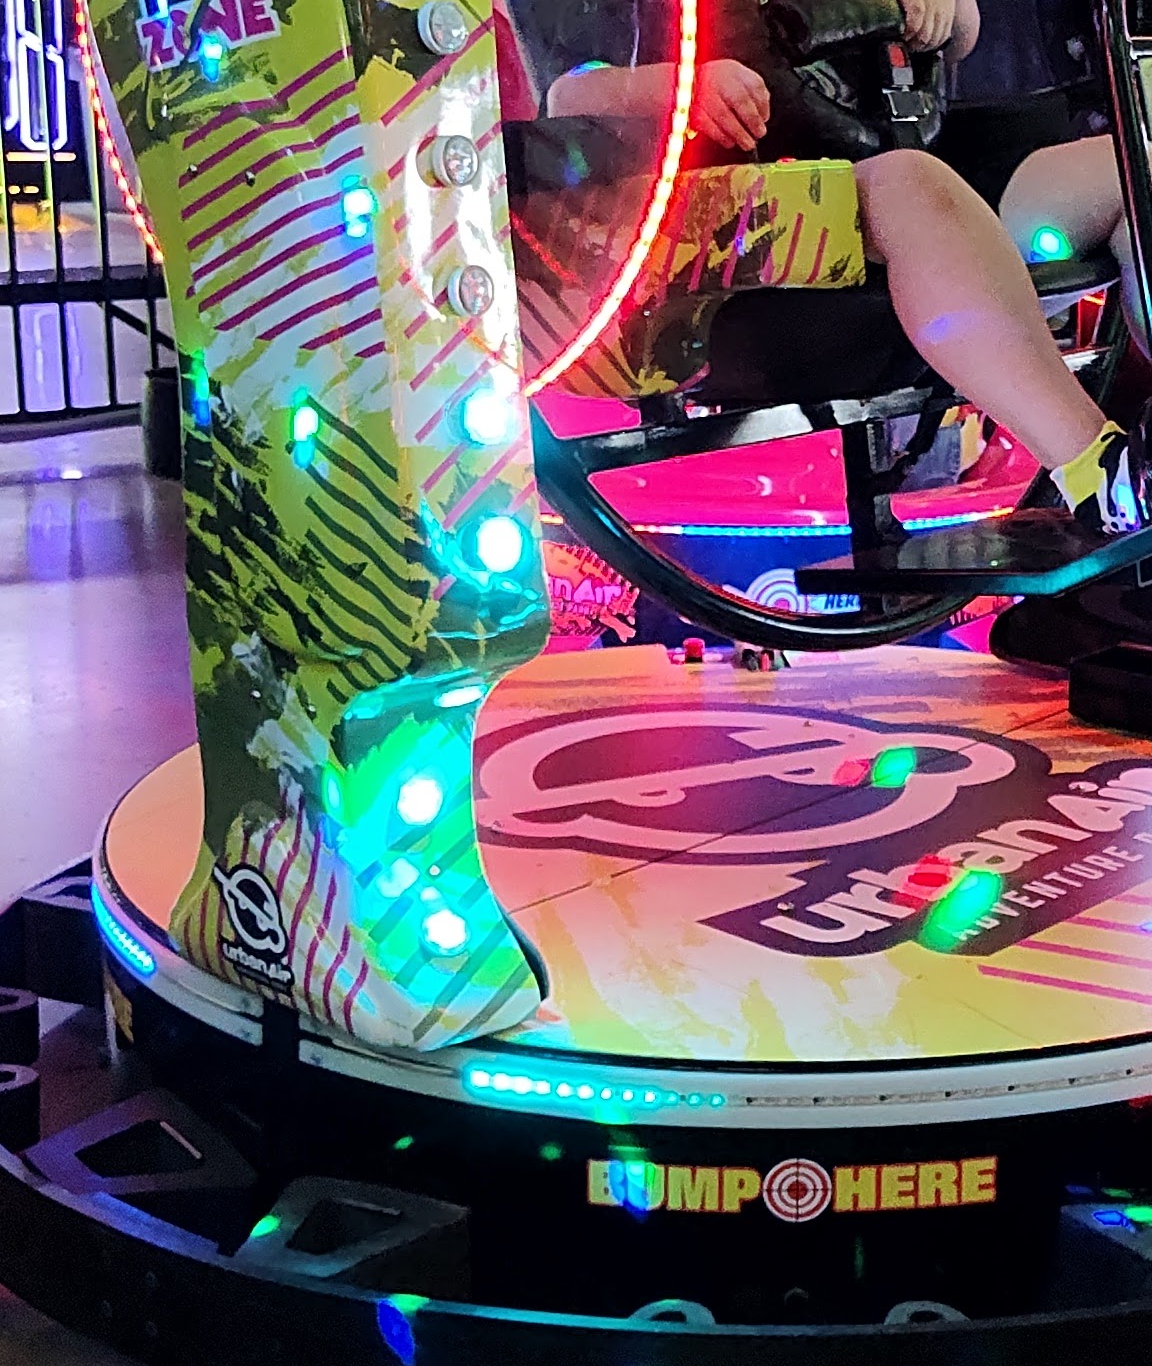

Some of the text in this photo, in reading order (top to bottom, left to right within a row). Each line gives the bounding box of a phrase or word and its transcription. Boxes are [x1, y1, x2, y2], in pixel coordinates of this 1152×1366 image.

[953, 845, 1145, 942] ADVENTURE
[586, 1155, 998, 1214] BUMP HERE
